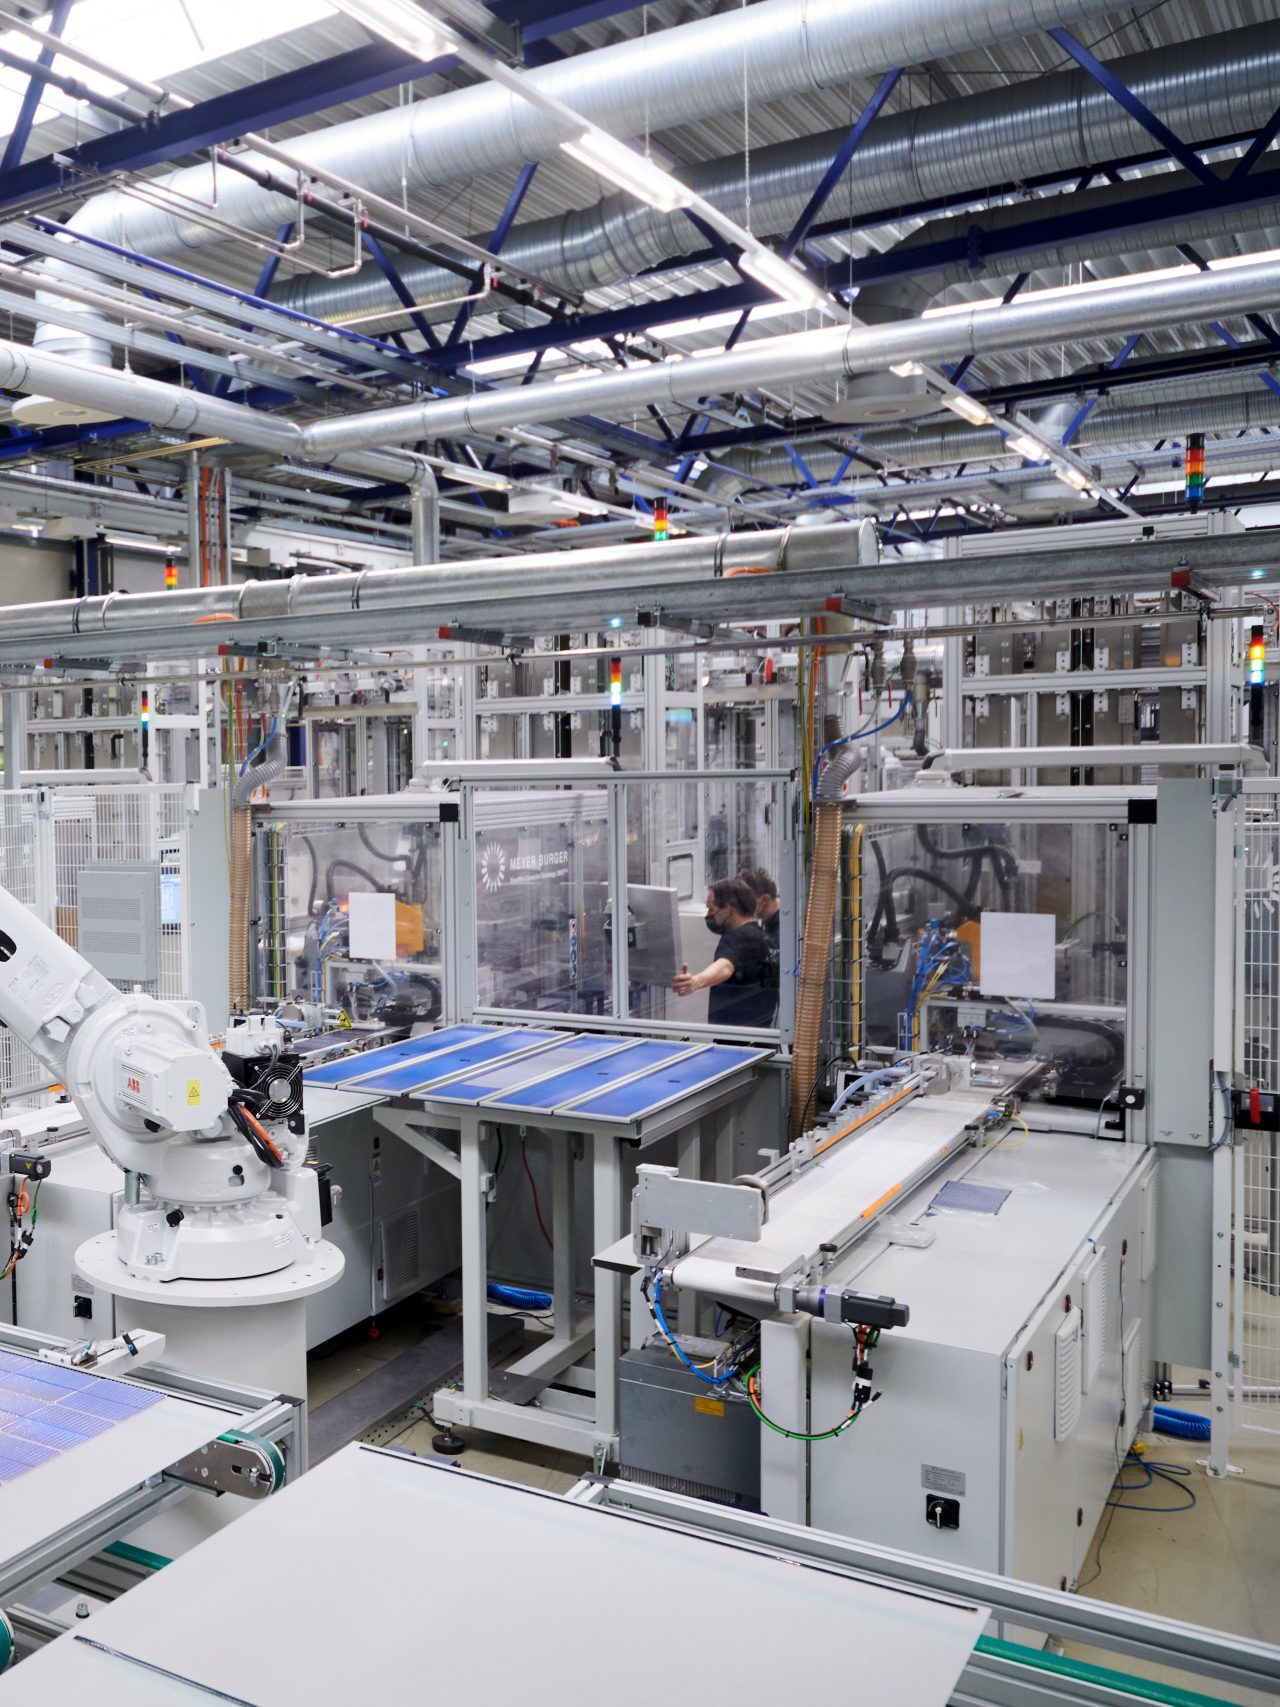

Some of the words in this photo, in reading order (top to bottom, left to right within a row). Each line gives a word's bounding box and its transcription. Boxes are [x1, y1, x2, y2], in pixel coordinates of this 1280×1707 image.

[510, 855, 536, 870] MEYER
[539, 850, 568, 866] BURGER
[127, 1076, 140, 1094] ABB
